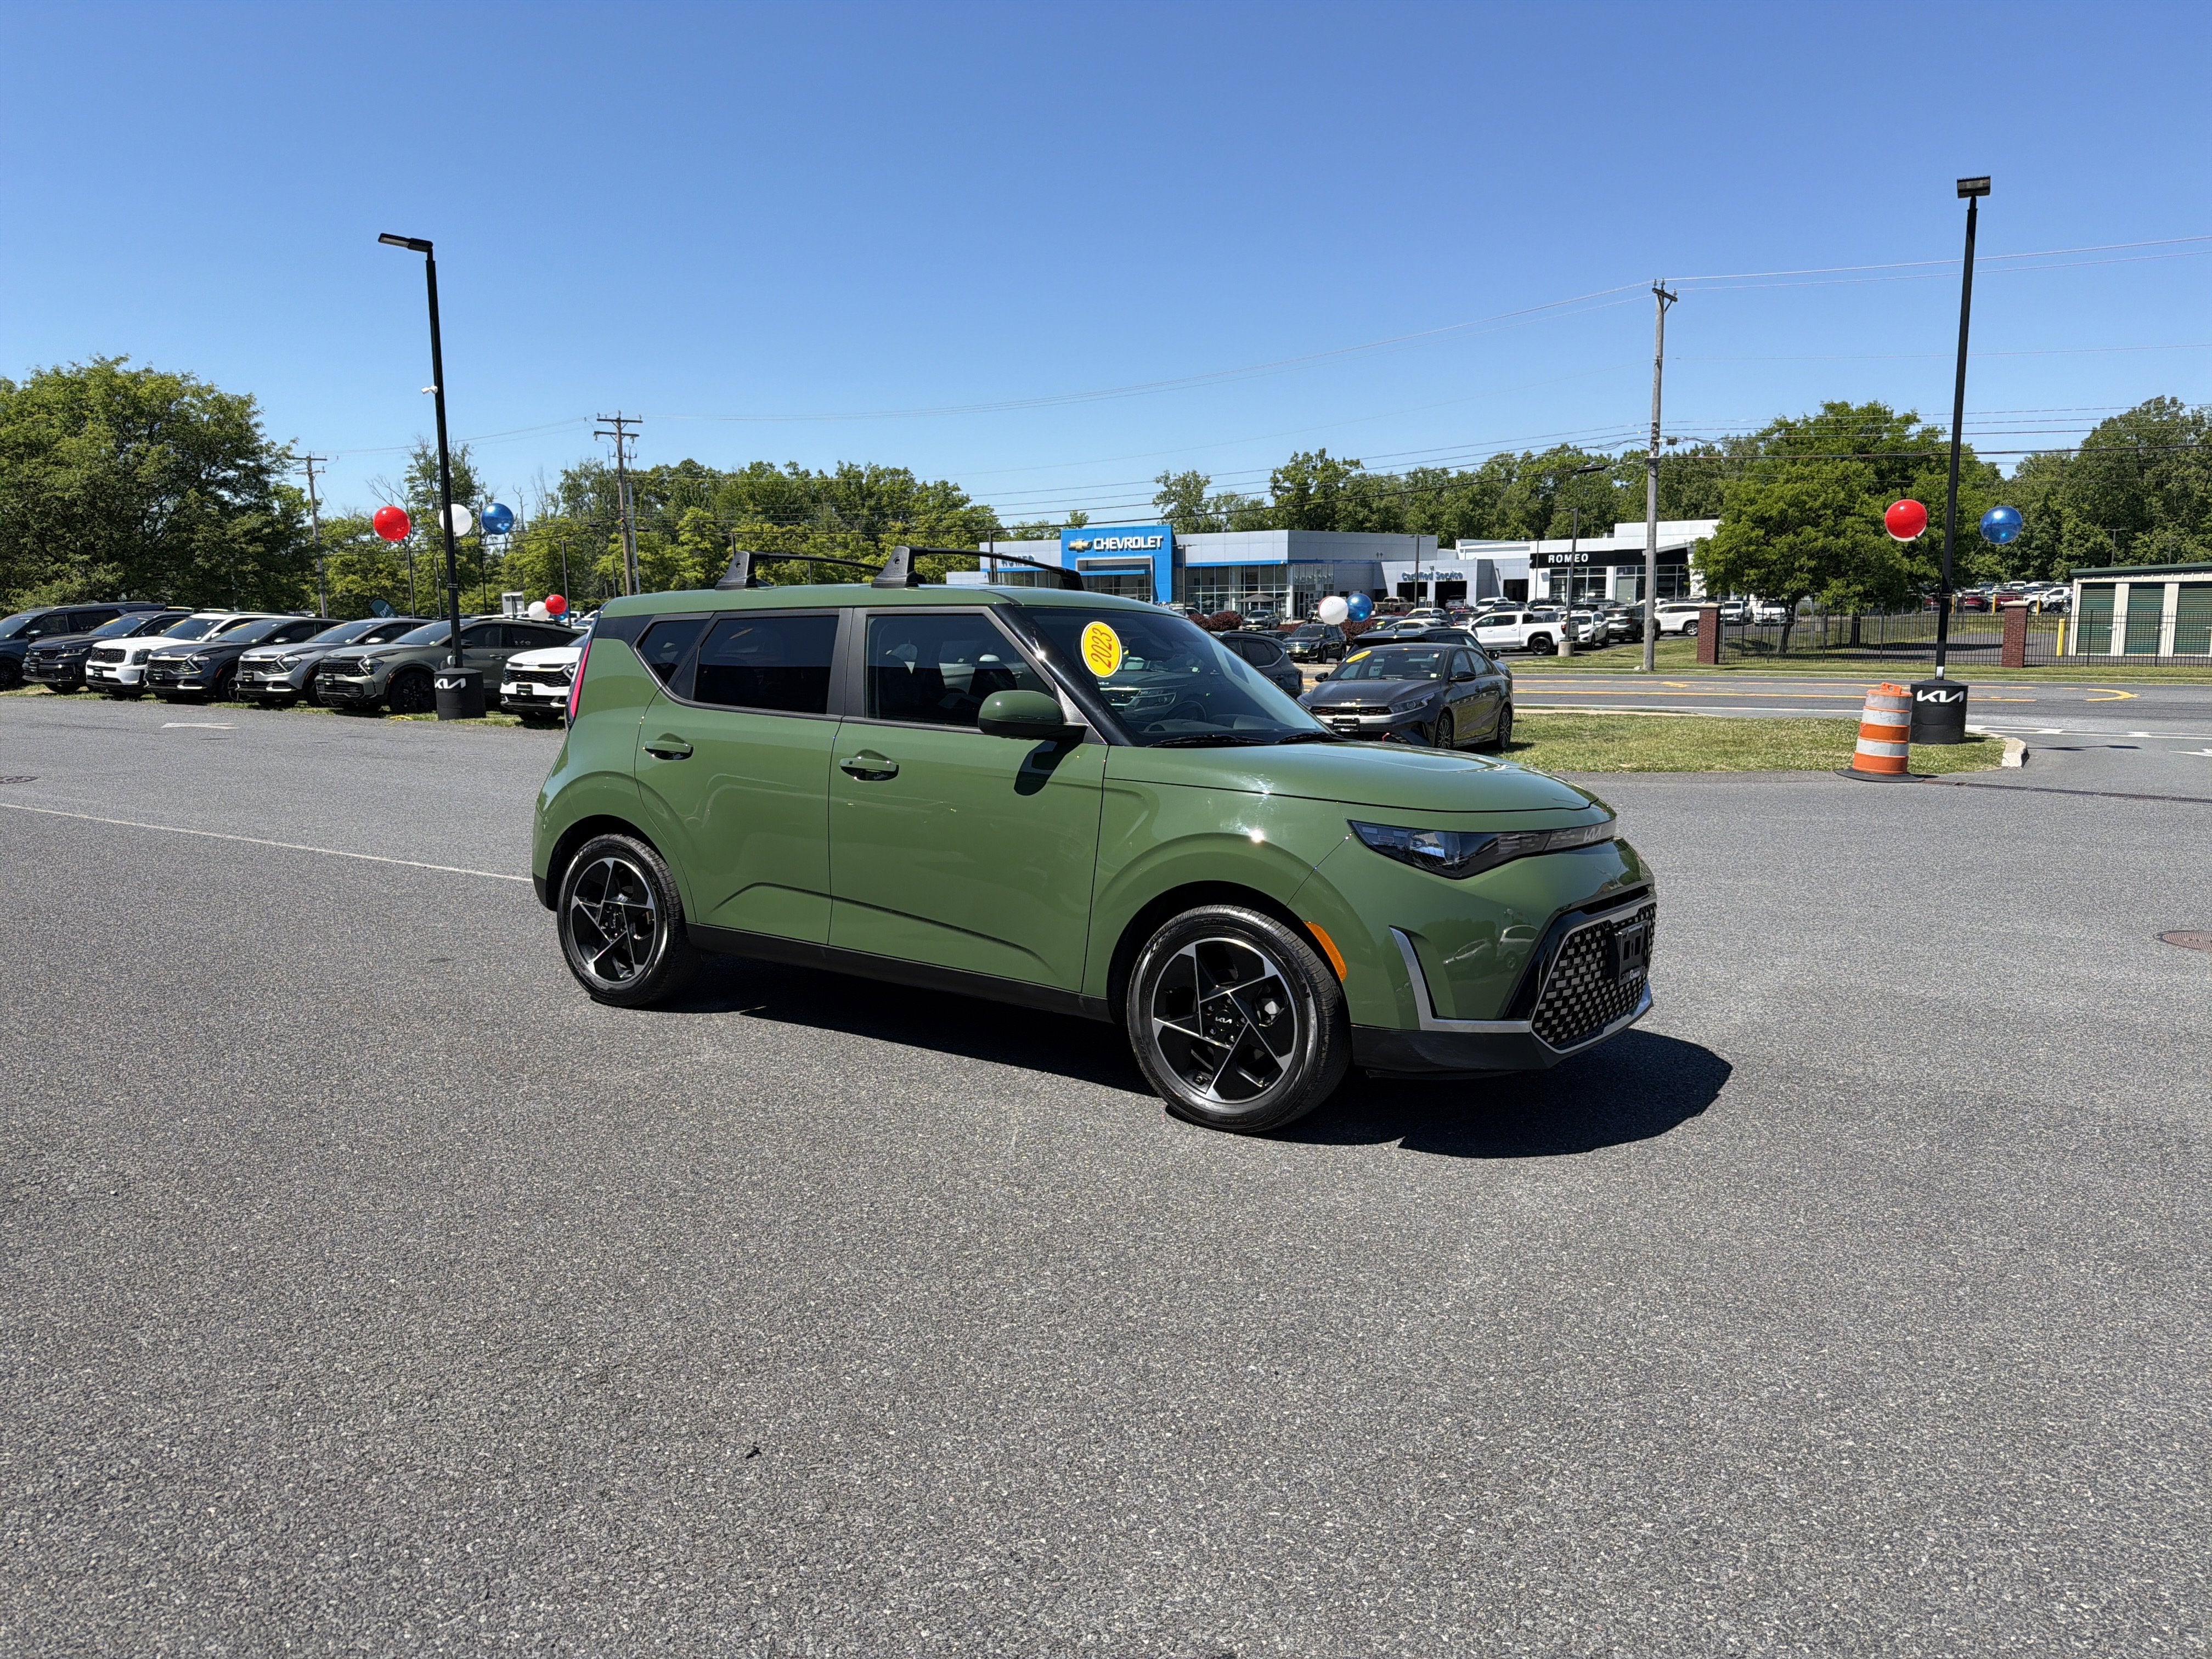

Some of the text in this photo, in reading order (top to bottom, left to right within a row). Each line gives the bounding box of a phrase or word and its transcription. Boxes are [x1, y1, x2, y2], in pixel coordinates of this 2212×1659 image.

[1093, 535, 1163, 550] CHEVROLET
[1548, 553, 1589, 563] ROMEO
[1091, 628, 1112, 669] 2023
[1916, 690, 1964, 703] KIA
[1583, 825, 1602, 843] KIA
[1215, 1016, 1232, 1024] KIA
